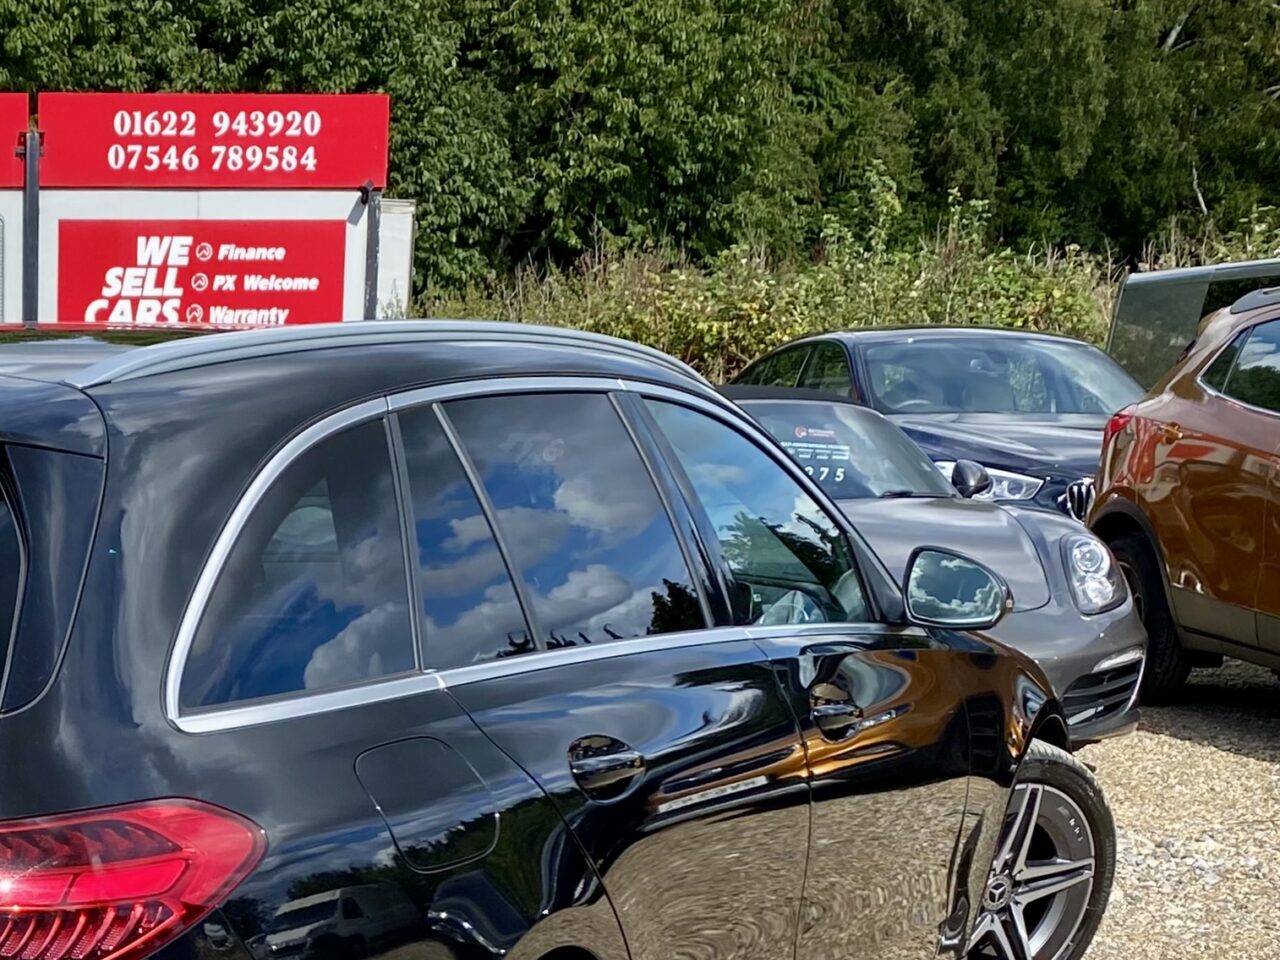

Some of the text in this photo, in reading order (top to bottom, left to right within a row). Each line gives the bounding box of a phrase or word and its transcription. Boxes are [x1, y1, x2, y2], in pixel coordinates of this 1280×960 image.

[113, 110, 322, 137] 01622 943920
[107, 144, 318, 172] 07546 789584
[136, 235, 194, 267] WE
[217, 243, 287, 262] Finance
[102, 267, 185, 298] SELL
[212, 274, 320, 291] PX Welcome
[84, 299, 183, 324] CARS
[209, 306, 290, 325] Warranty
